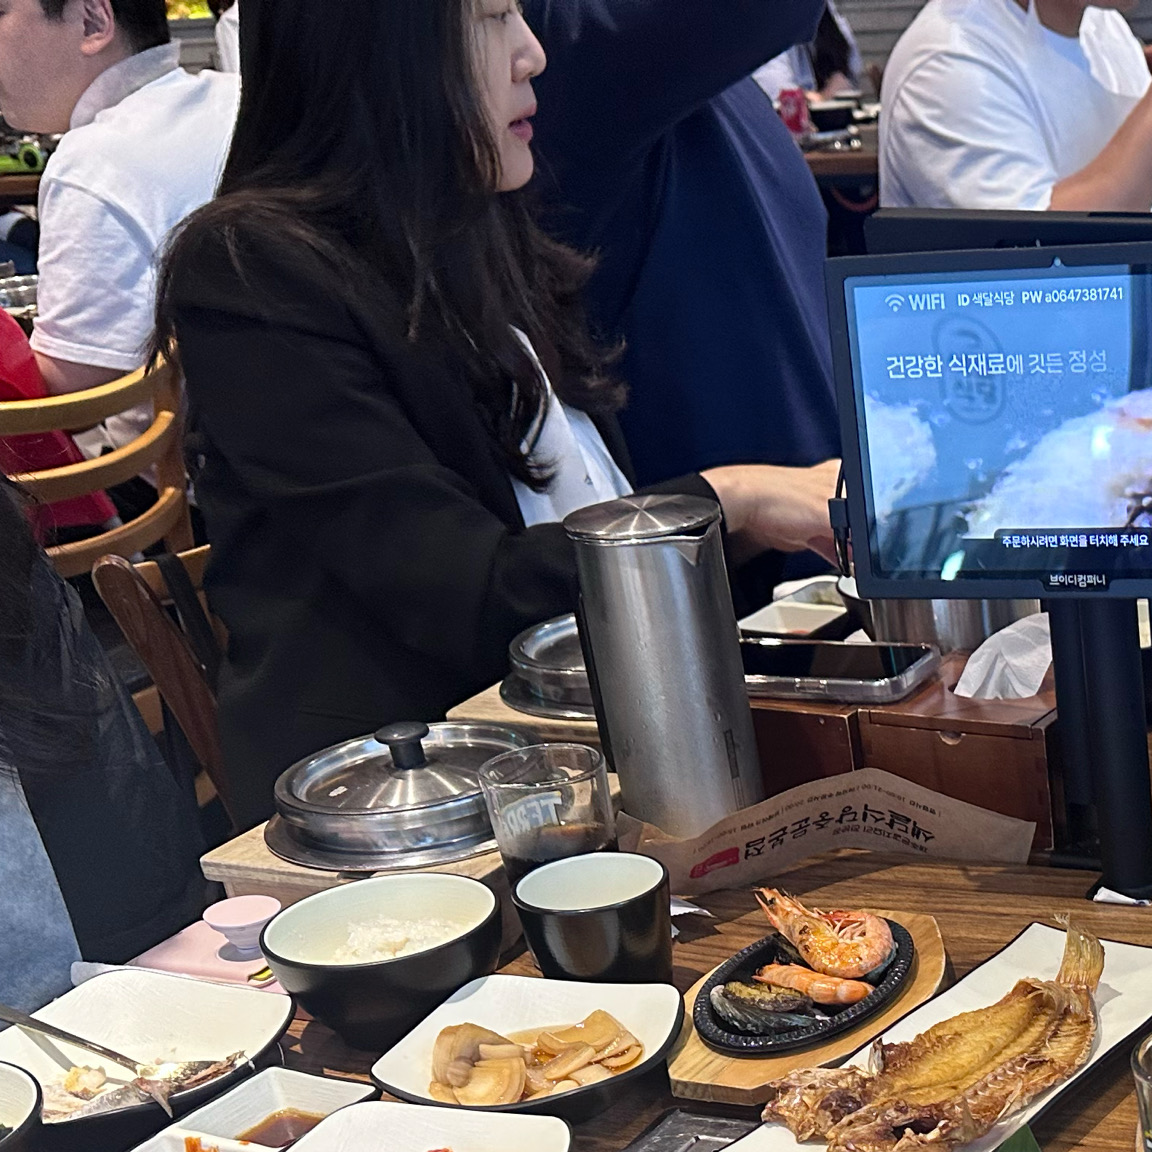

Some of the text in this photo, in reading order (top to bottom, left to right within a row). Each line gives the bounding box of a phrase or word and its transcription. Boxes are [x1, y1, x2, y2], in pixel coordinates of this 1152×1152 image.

[909, 287, 1123, 311] WIFI ID 색달식당 PW a0647381741
[886, 349, 1108, 379] 건강한 식재료에 깃든 정성
[1002, 534, 1149, 548] 주문하시려면 화면을 터치해 주세요
[1049, 574, 1107, 588] 브이디컴퍼니
